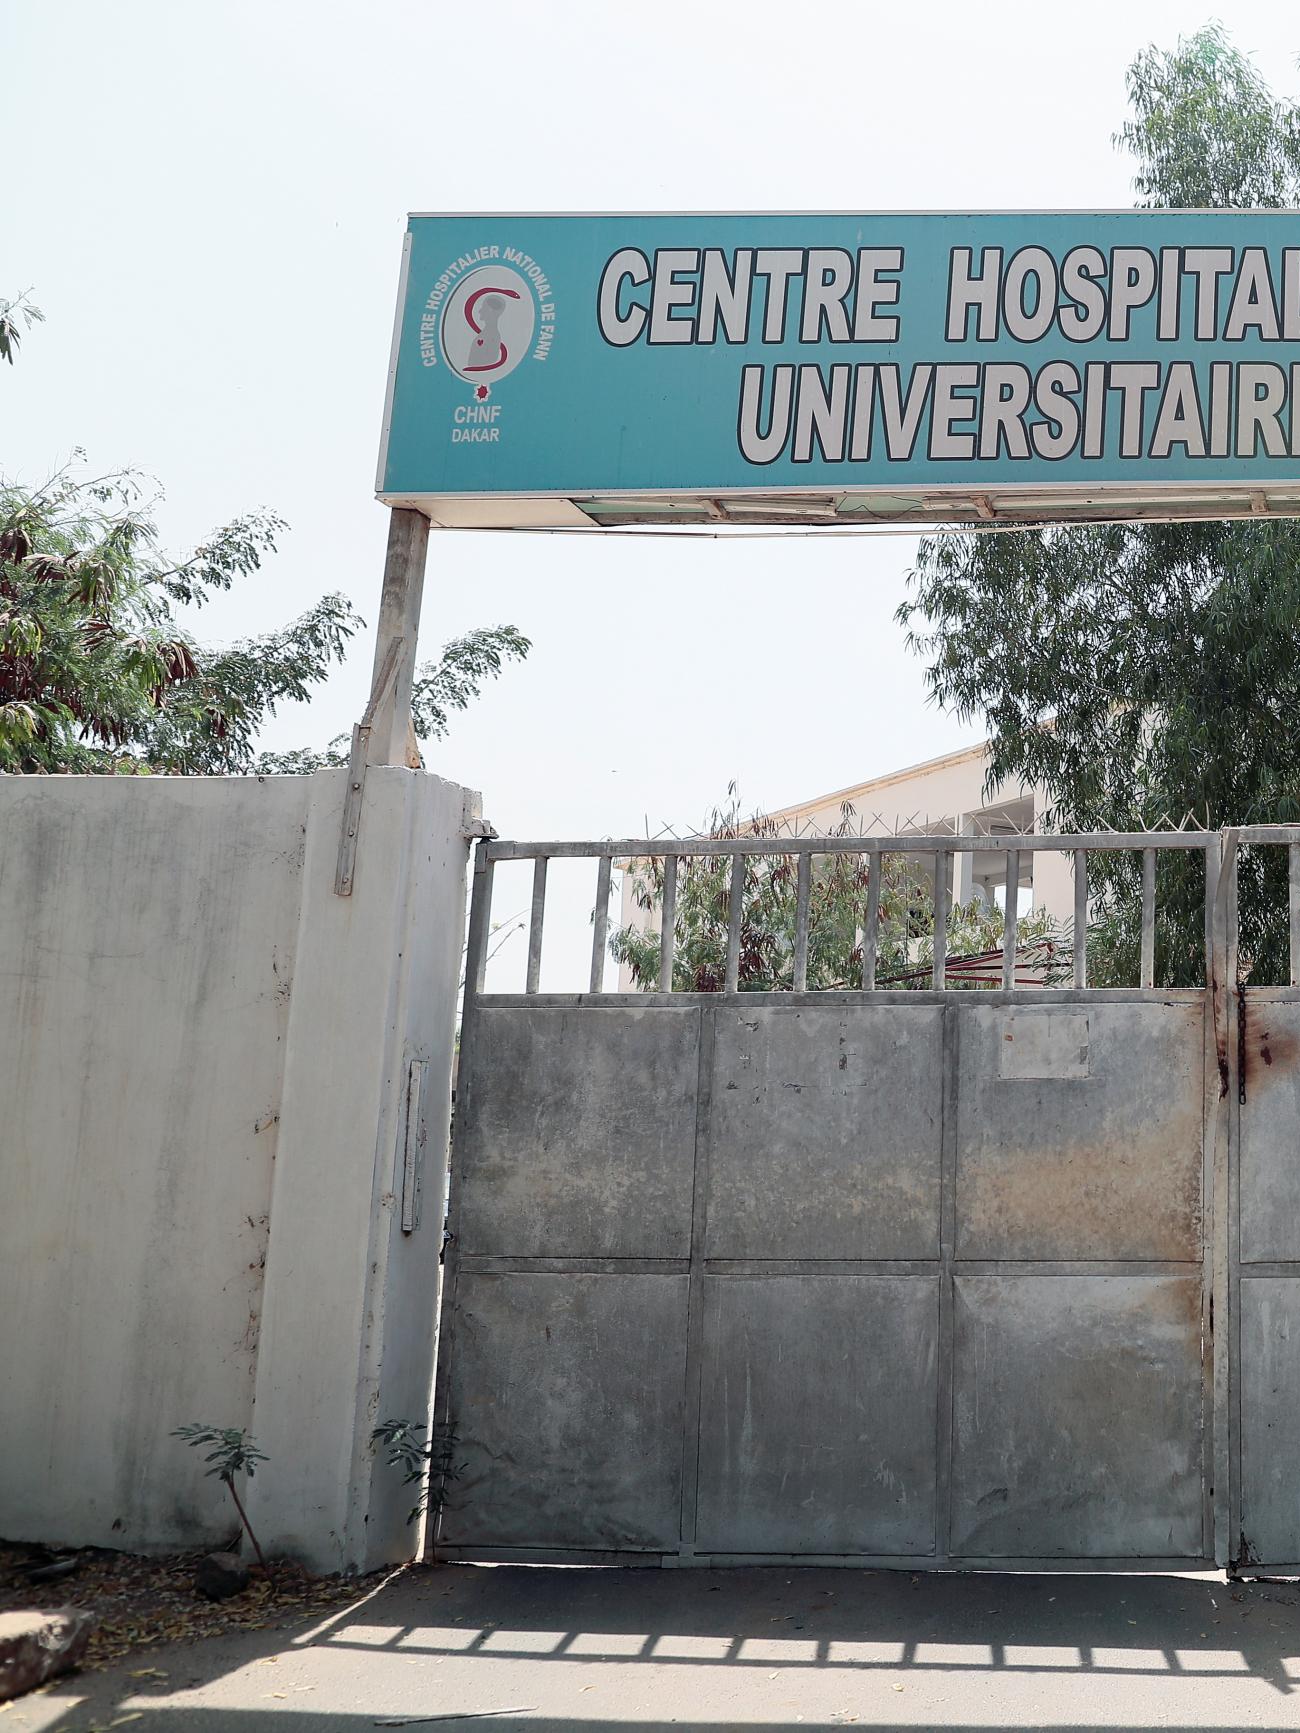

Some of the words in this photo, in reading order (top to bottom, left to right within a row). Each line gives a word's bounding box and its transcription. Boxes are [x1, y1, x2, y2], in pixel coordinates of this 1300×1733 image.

[426, 245, 500, 311] HOSPITALIER
[503, 246, 552, 301] NATIONAL
[598, 246, 904, 346] CENTRE
[541, 303, 555, 321] DE
[420, 313, 437, 367] CENTRE
[533, 324, 555, 361] FANN
[452, 428, 500, 442] DAKAR
[454, 405, 502, 424] CHNF
